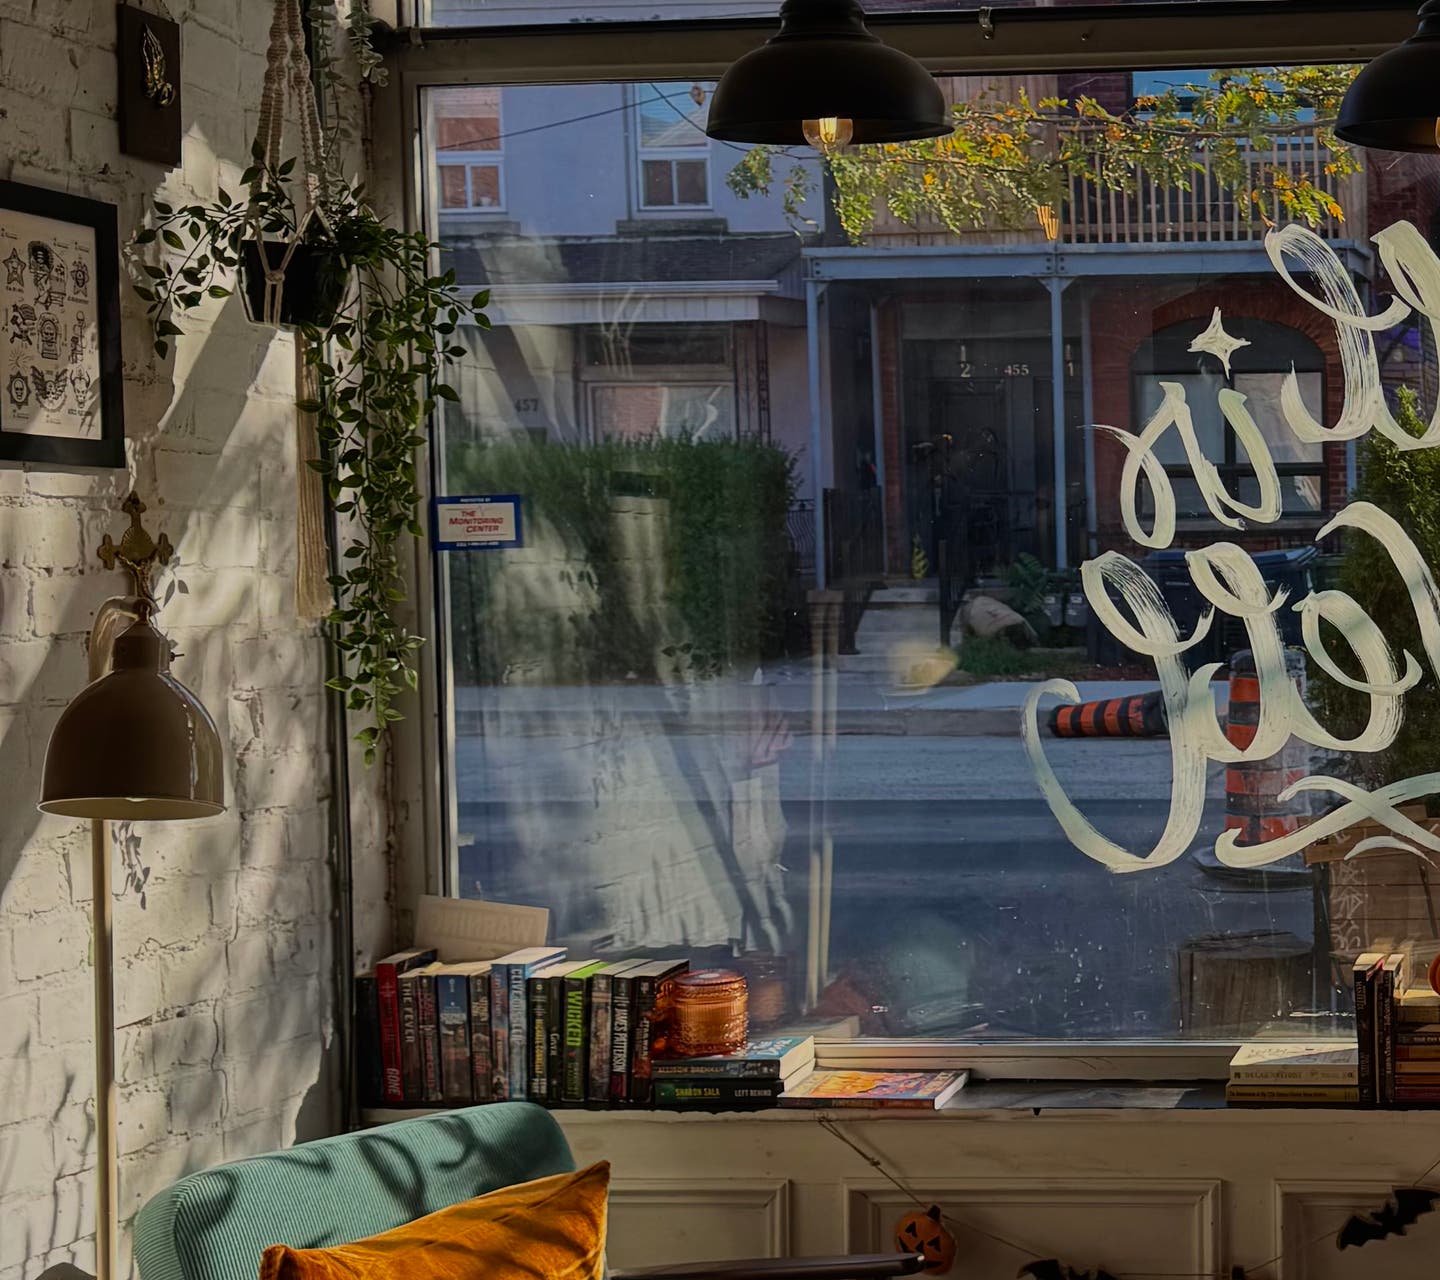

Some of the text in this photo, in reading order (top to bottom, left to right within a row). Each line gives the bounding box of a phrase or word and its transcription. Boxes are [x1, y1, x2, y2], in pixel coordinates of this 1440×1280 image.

[1004, 364, 1030, 376] 455
[515, 399, 538, 412] 457
[449, 517, 504, 525] MONITORING
[466, 525, 500, 533] CENTER
[510, 968, 524, 995] CLIVE
[403, 981, 414, 1043] THE FEVER
[566, 990, 584, 1047] WICKED
[613, 1007, 627, 1073] JAMES PATTERSON
[387, 1067, 401, 1096] GONE
